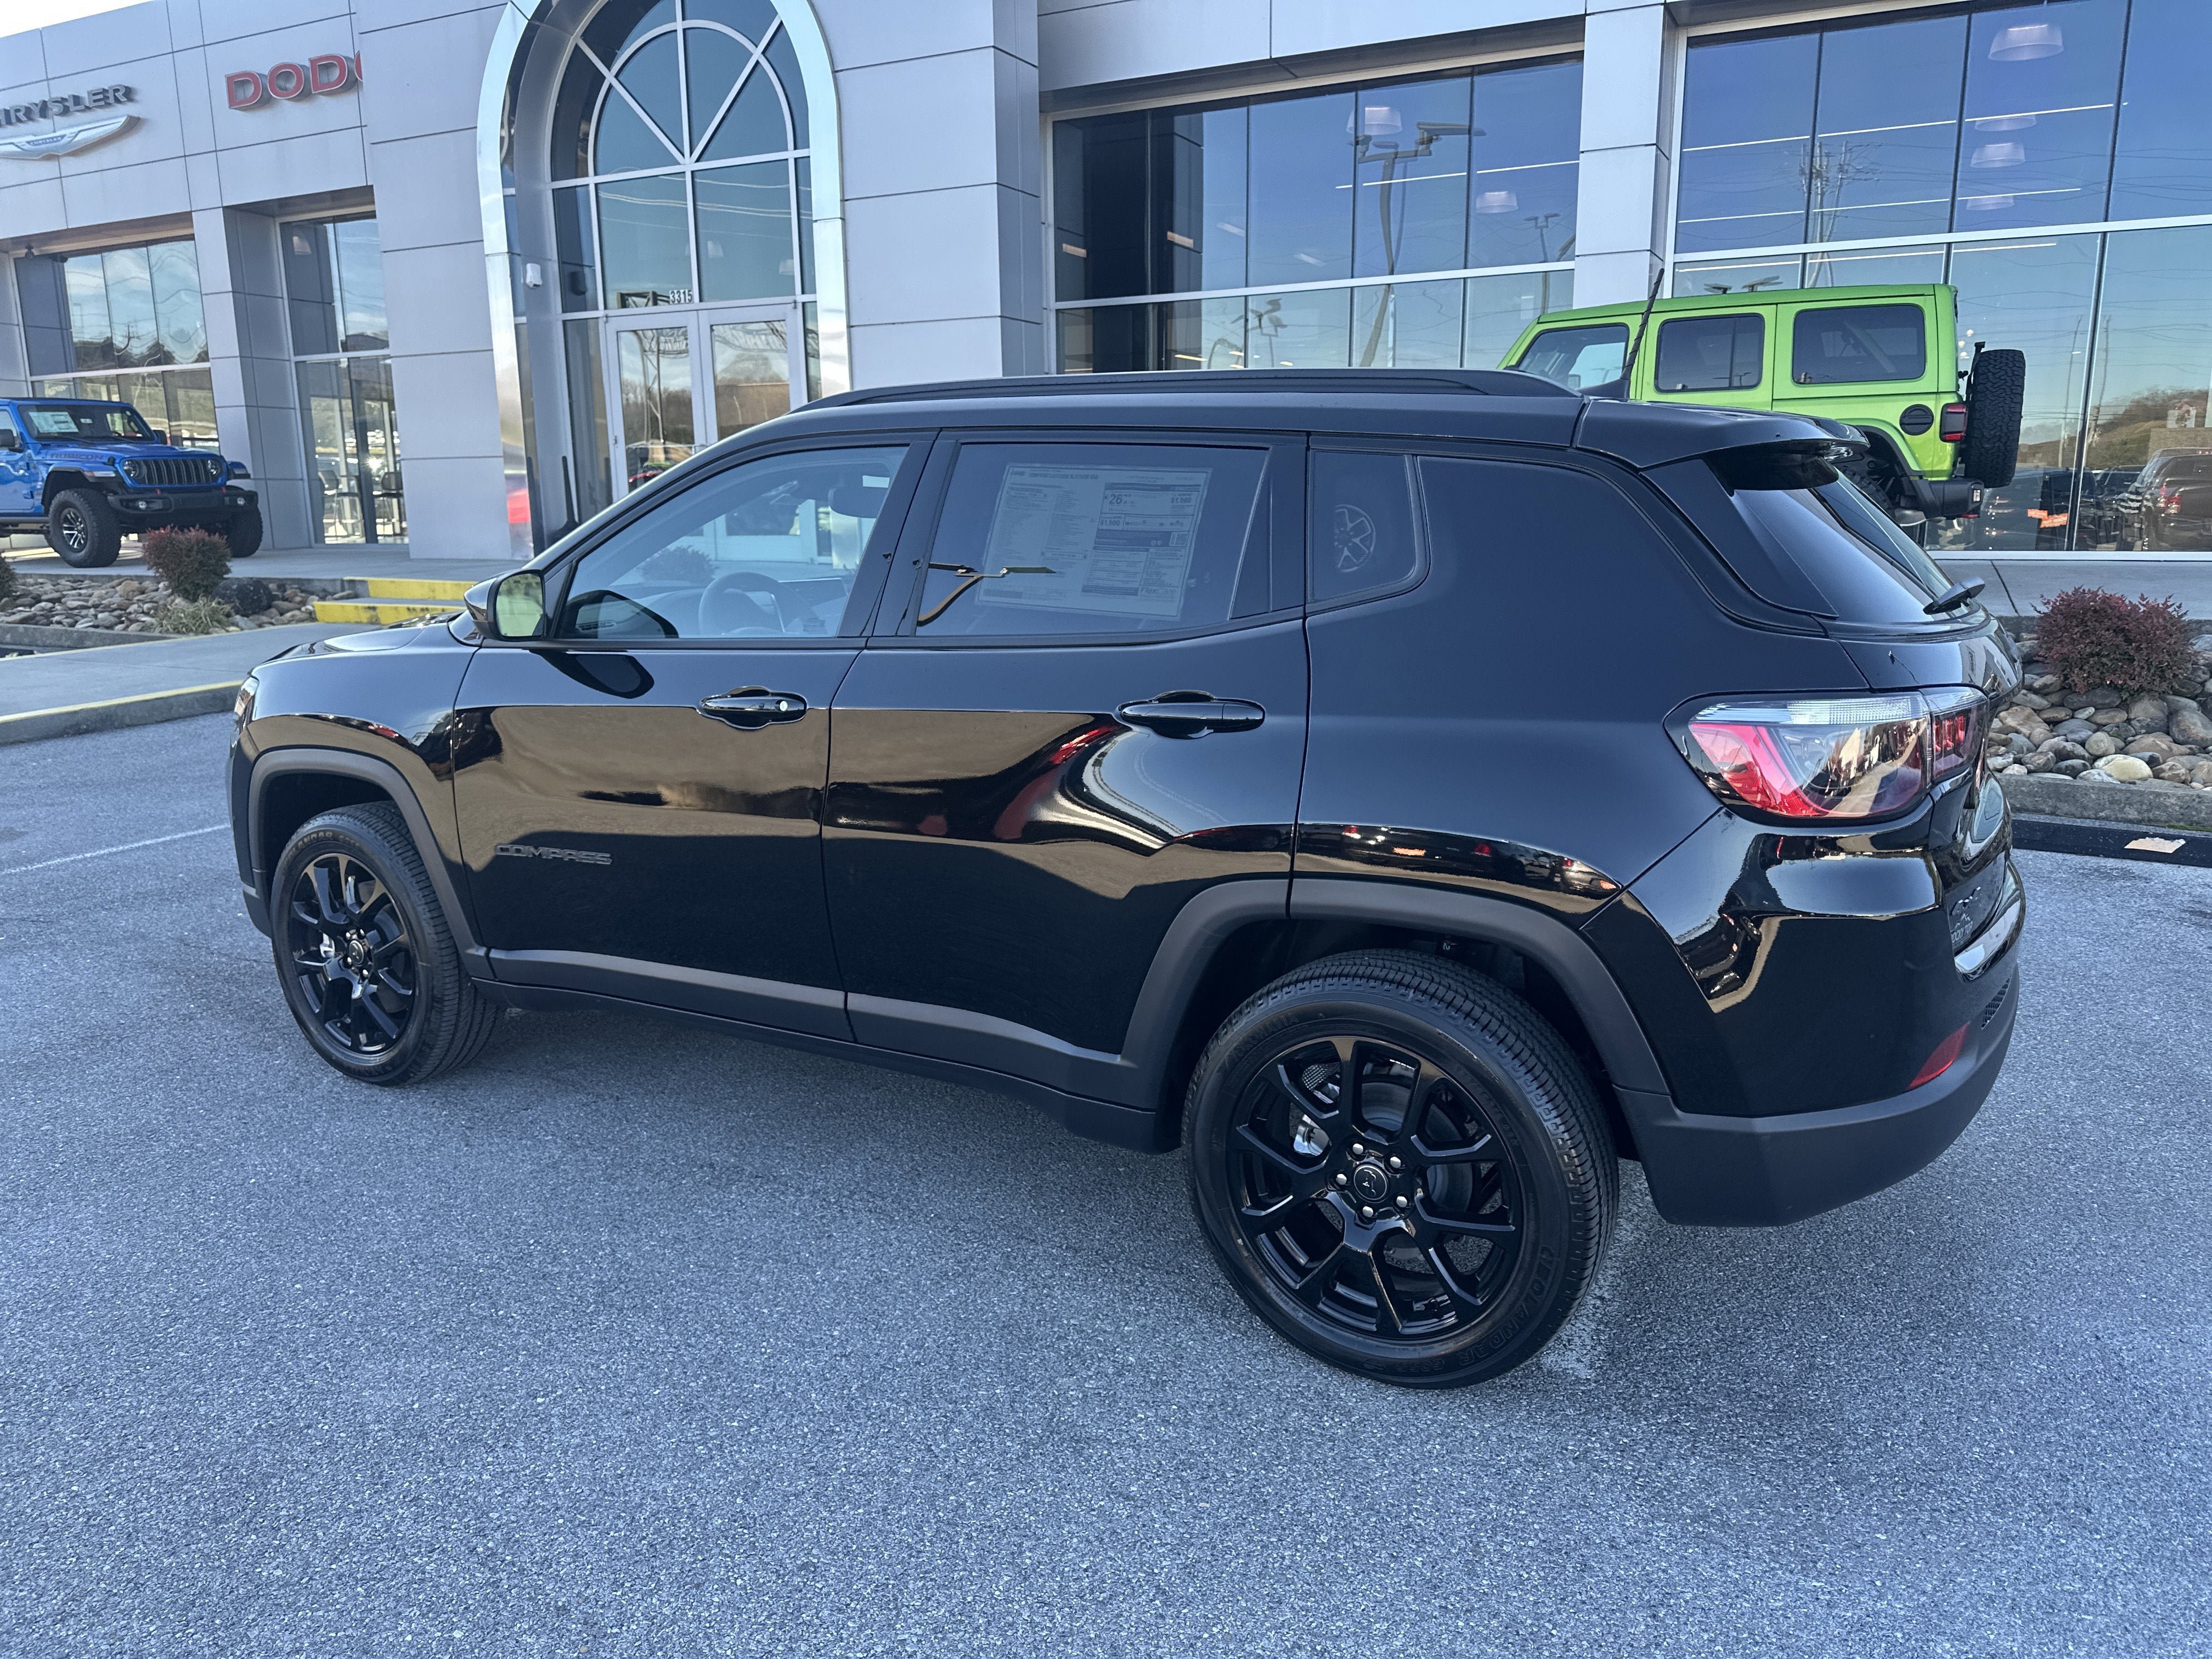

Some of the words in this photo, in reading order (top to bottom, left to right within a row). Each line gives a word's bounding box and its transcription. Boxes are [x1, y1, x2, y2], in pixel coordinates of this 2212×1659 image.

[225, 50, 363, 109] DOD
[670, 289, 692, 303] 3315
[495, 843, 612, 865] COMPASS
